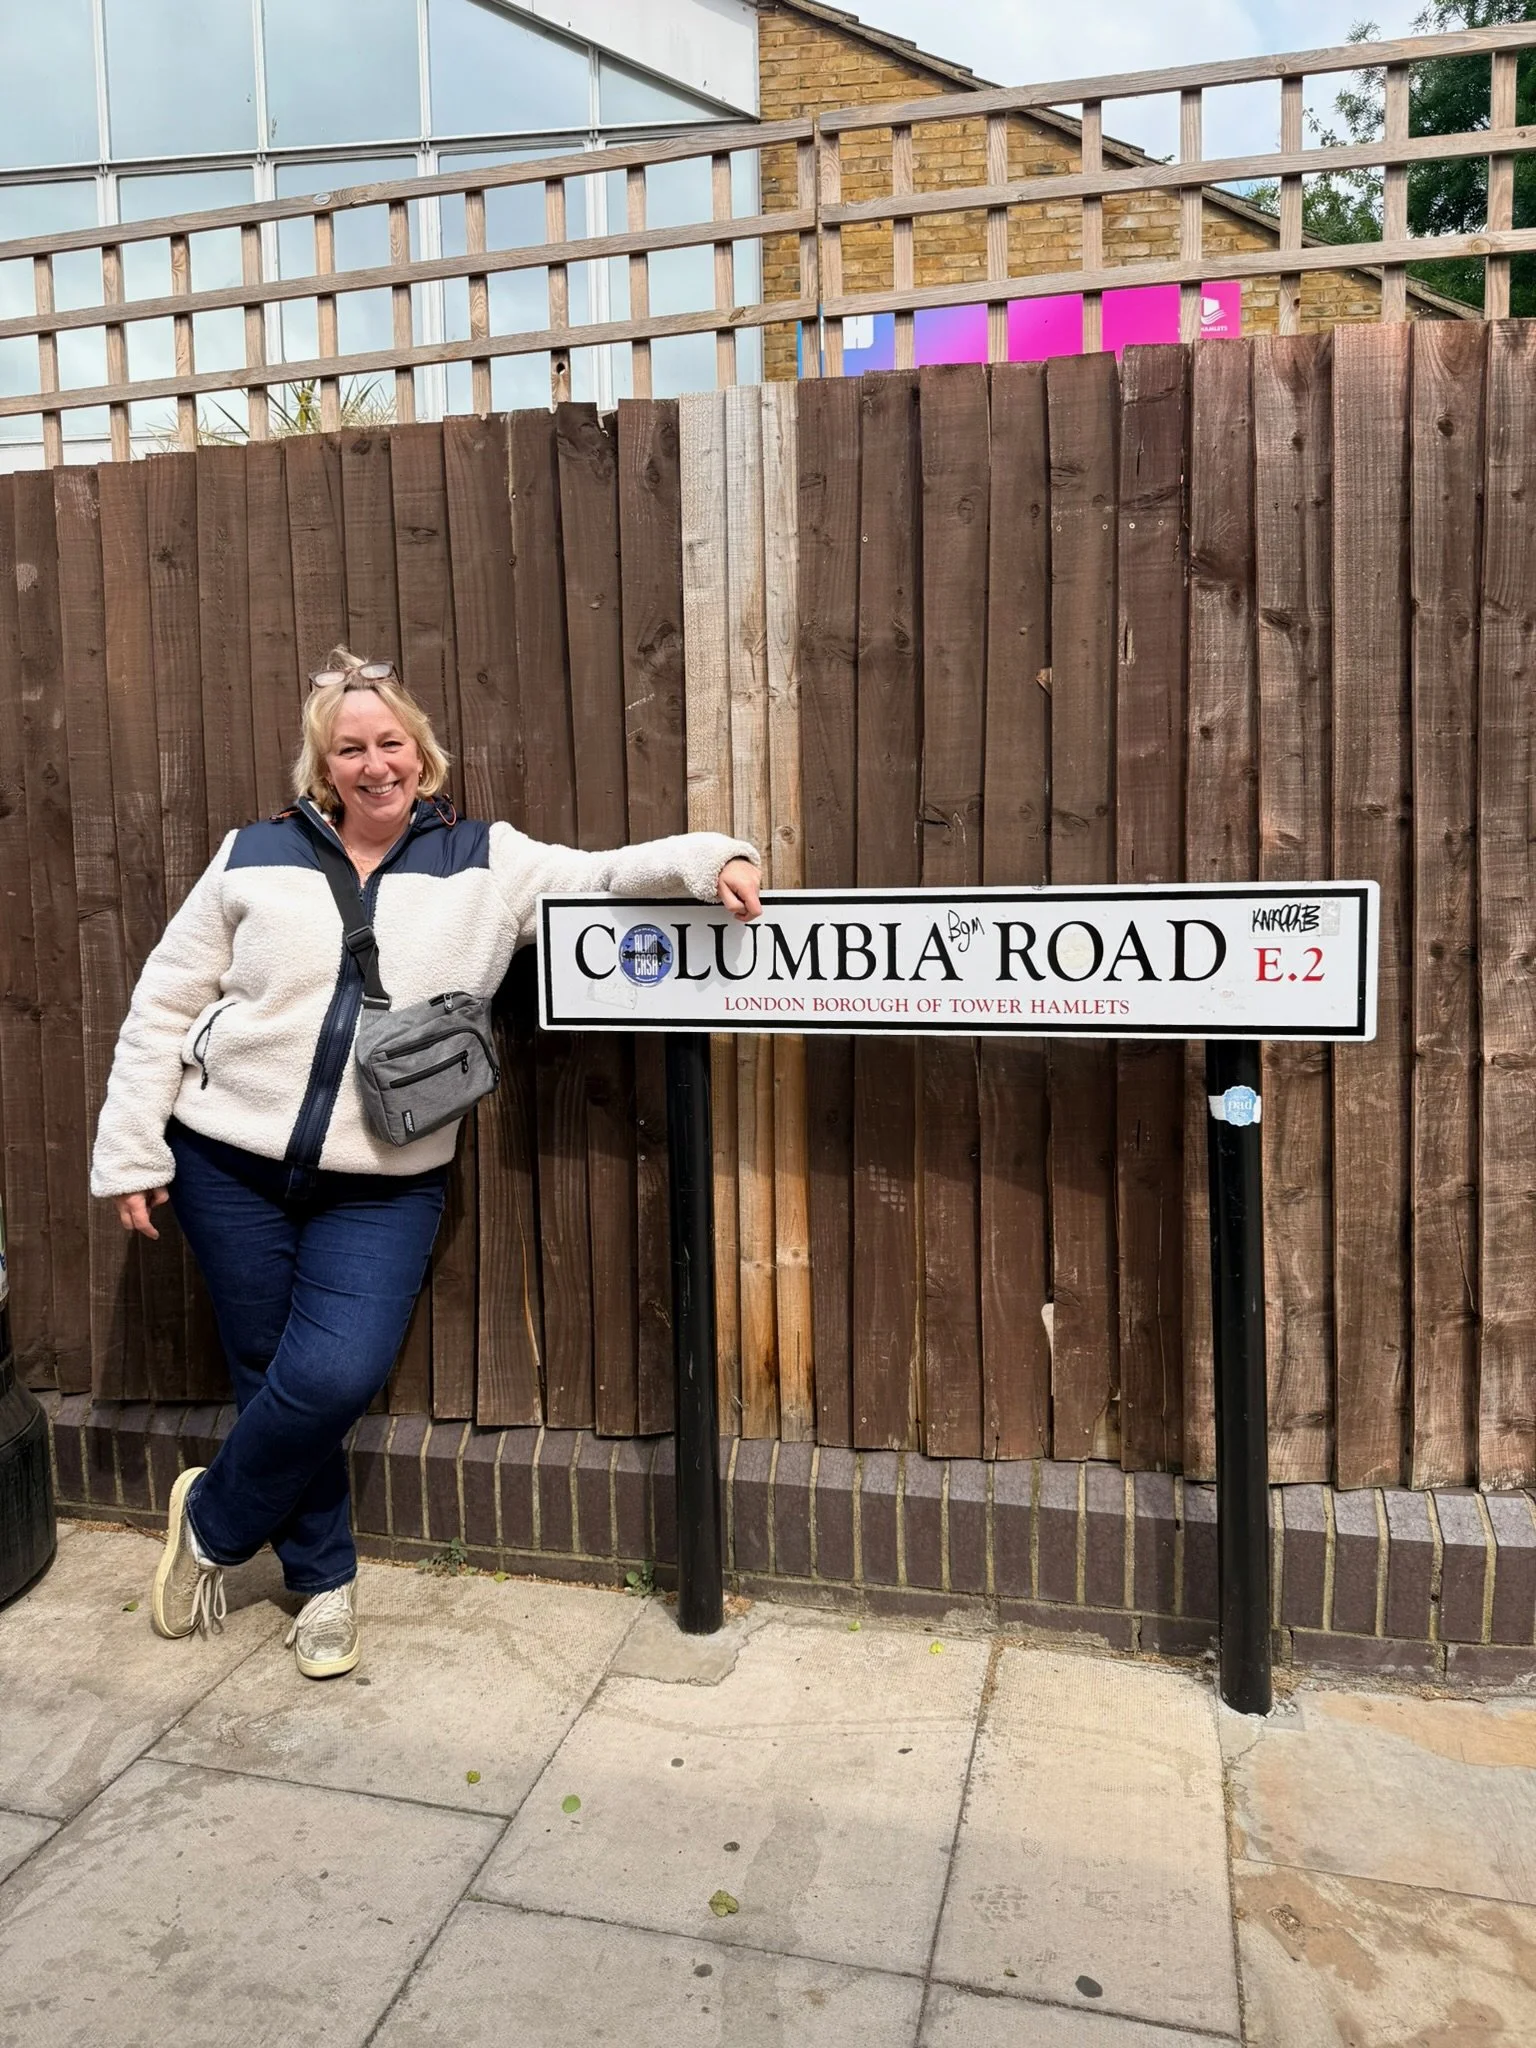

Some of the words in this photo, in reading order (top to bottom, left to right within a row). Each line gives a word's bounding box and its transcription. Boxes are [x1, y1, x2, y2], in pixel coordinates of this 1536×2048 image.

[575, 922, 963, 982] CLUMBIA
[992, 918, 1227, 983] ROAD
[634, 934, 658, 953] ALMA
[634, 954, 658, 976] CASA
[1255, 946, 1325, 983] E.2
[725, 996, 805, 1012] LONDON
[813, 997, 909, 1013] BOROUGH
[917, 998, 942, 1013] OF
[951, 998, 1023, 1014] TOWER
[1031, 999, 1130, 1016] HAMLETS
